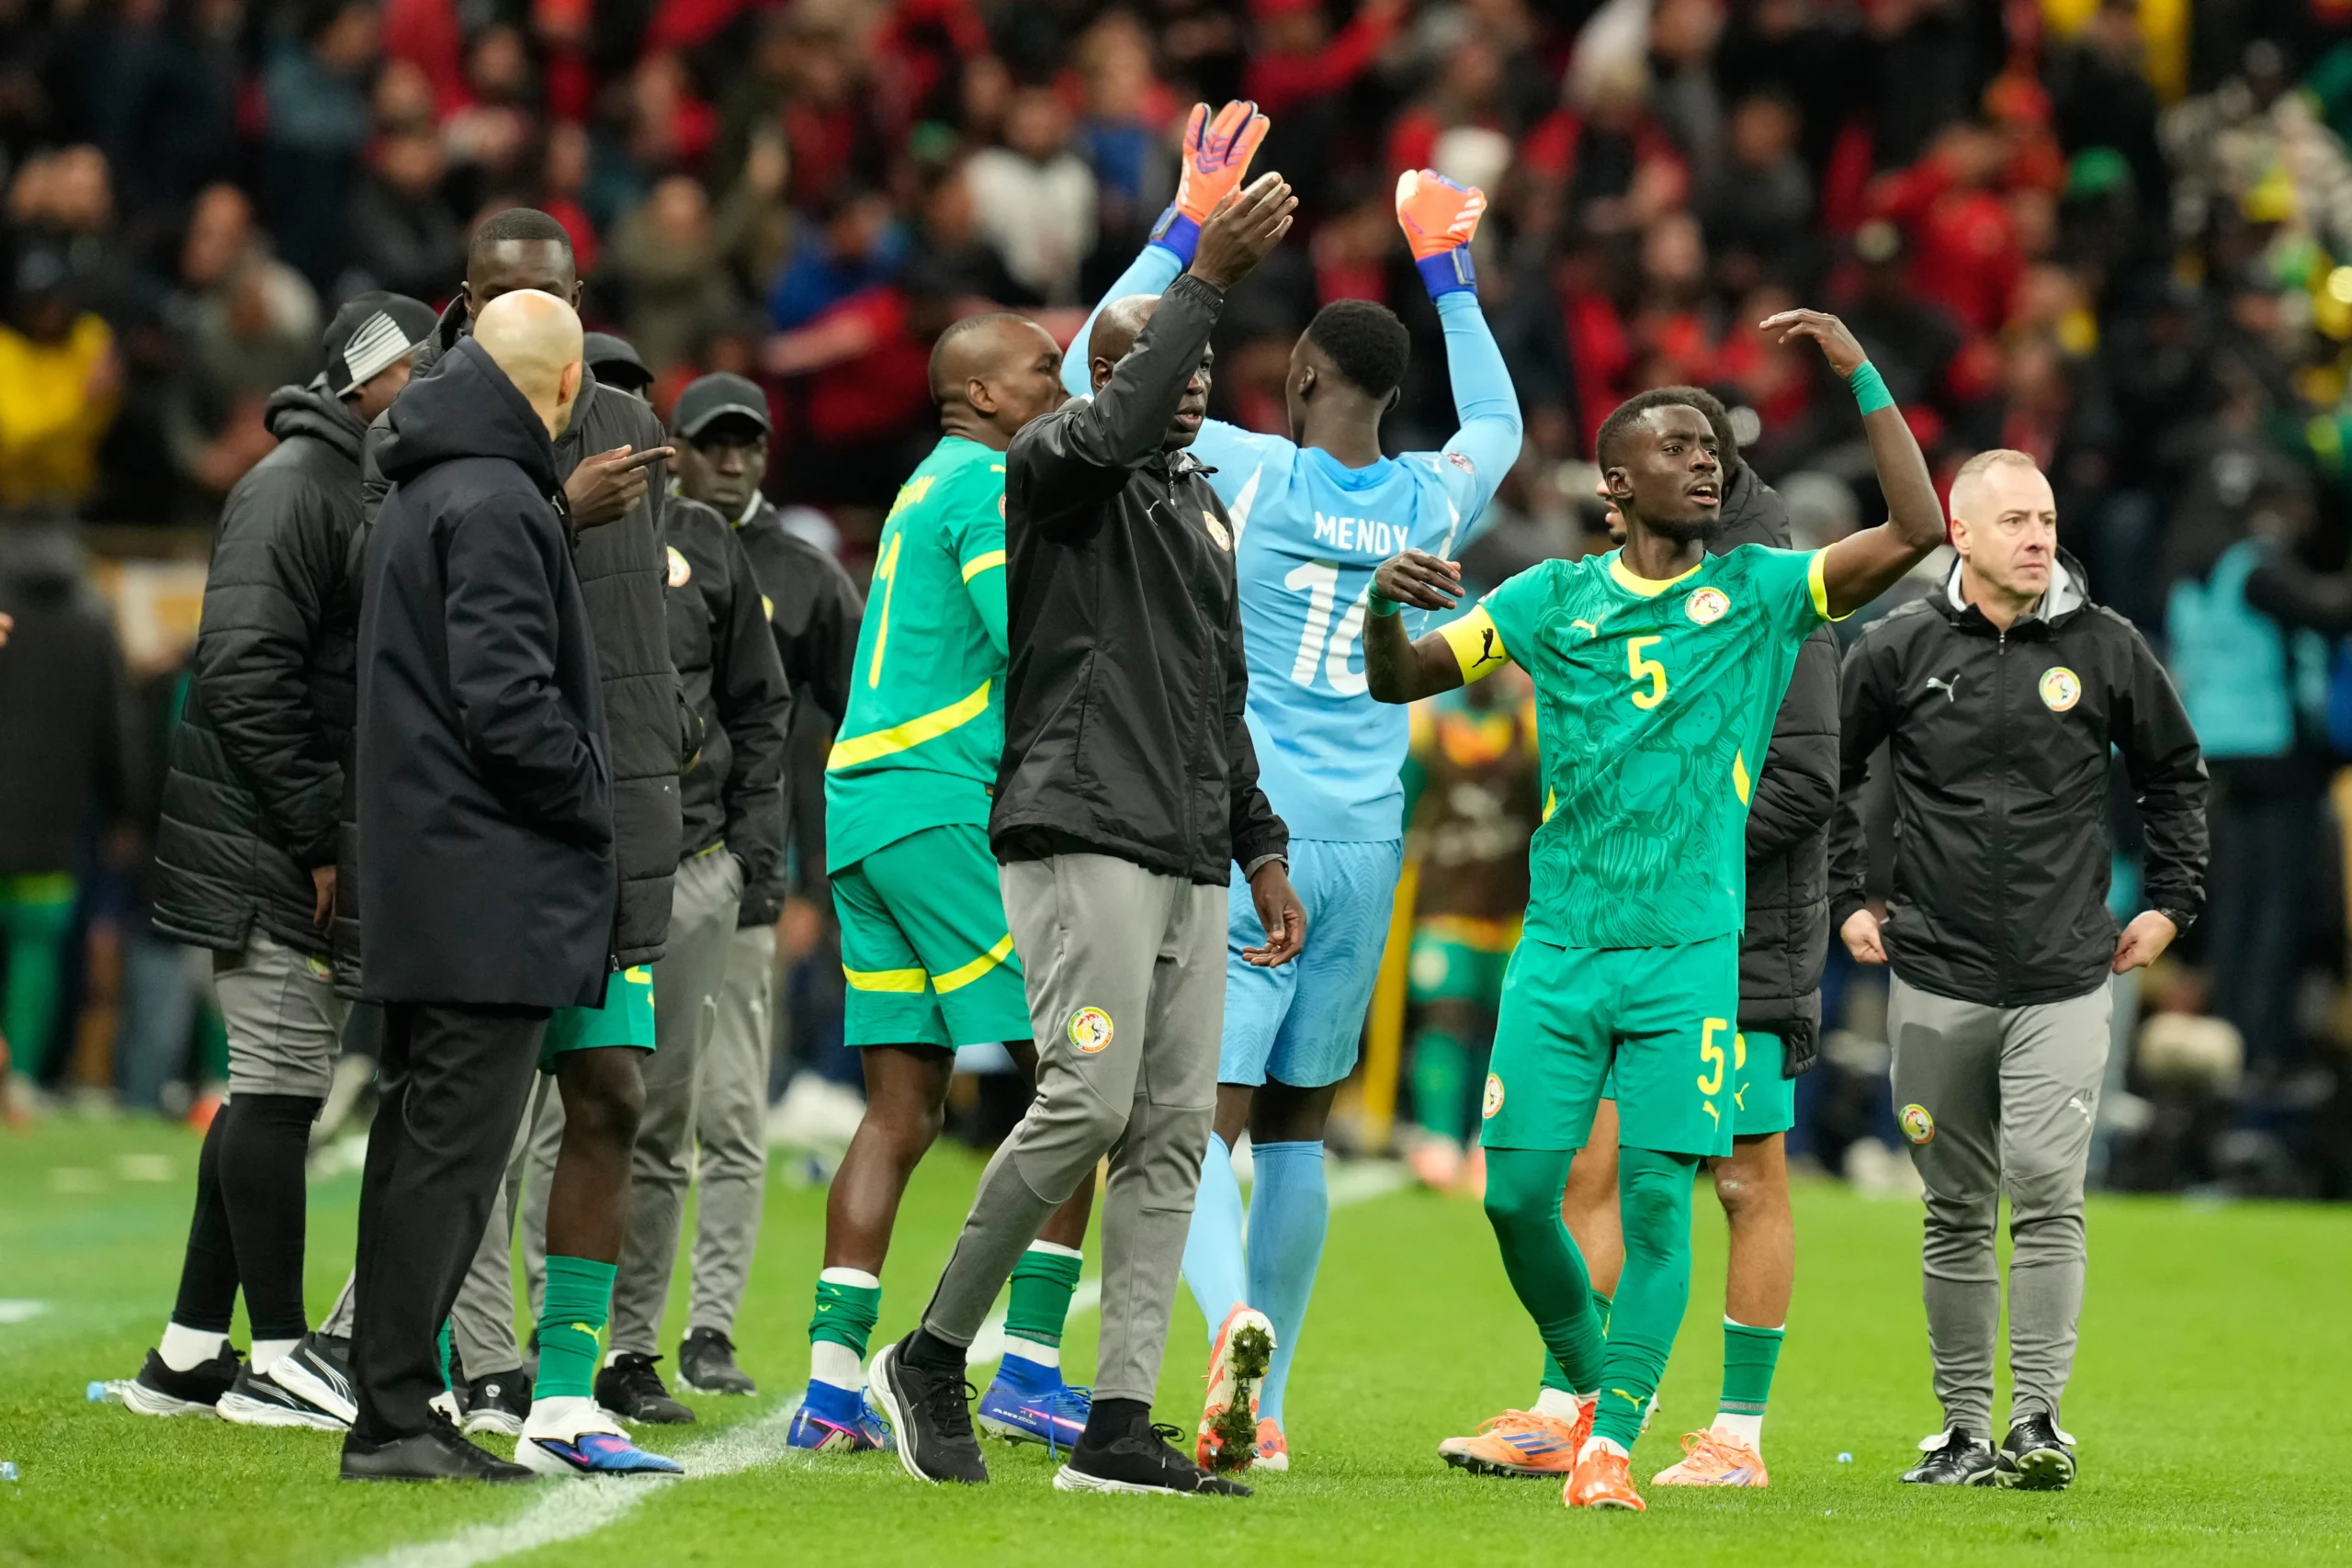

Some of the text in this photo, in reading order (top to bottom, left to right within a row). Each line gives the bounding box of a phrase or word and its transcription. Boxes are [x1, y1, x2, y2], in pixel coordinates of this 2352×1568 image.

[1313, 511, 1408, 556] MENDY
[868, 531, 901, 689] 1
[1627, 635, 1668, 709] 5
[1697, 1017, 1727, 1096] 5
